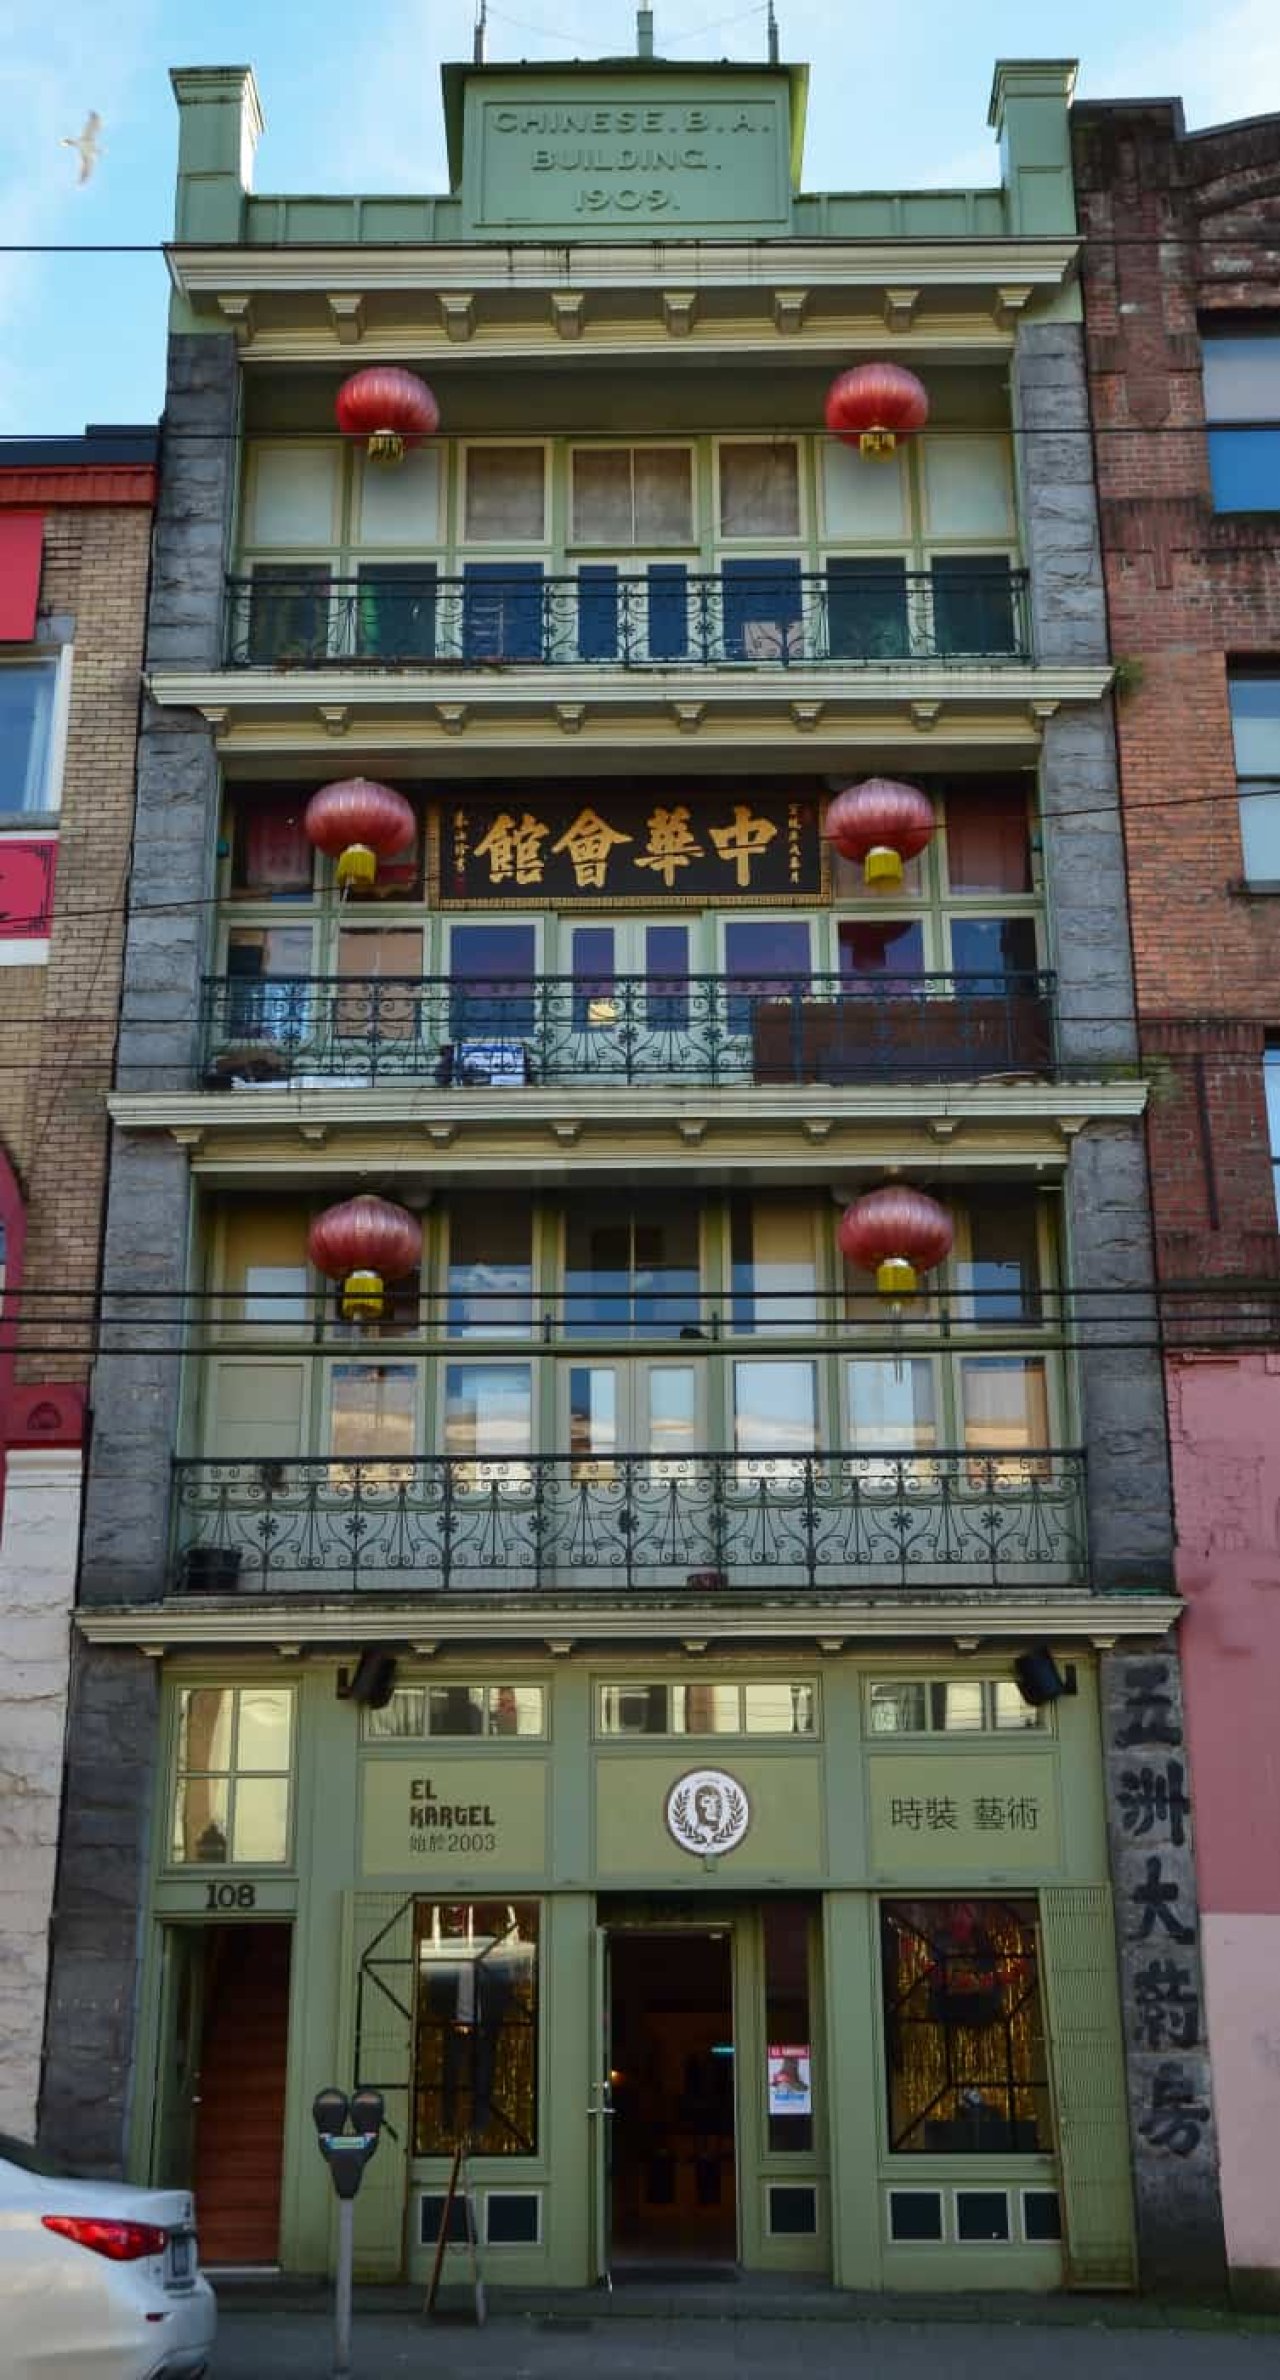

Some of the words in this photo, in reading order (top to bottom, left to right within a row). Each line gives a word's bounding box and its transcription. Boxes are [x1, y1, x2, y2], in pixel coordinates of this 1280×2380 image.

[410, 1779, 438, 1801] EL
[891, 1796, 957, 1831] 時裝
[972, 1796, 1040, 1831] 藝術
[205, 1883, 256, 1909] 108
